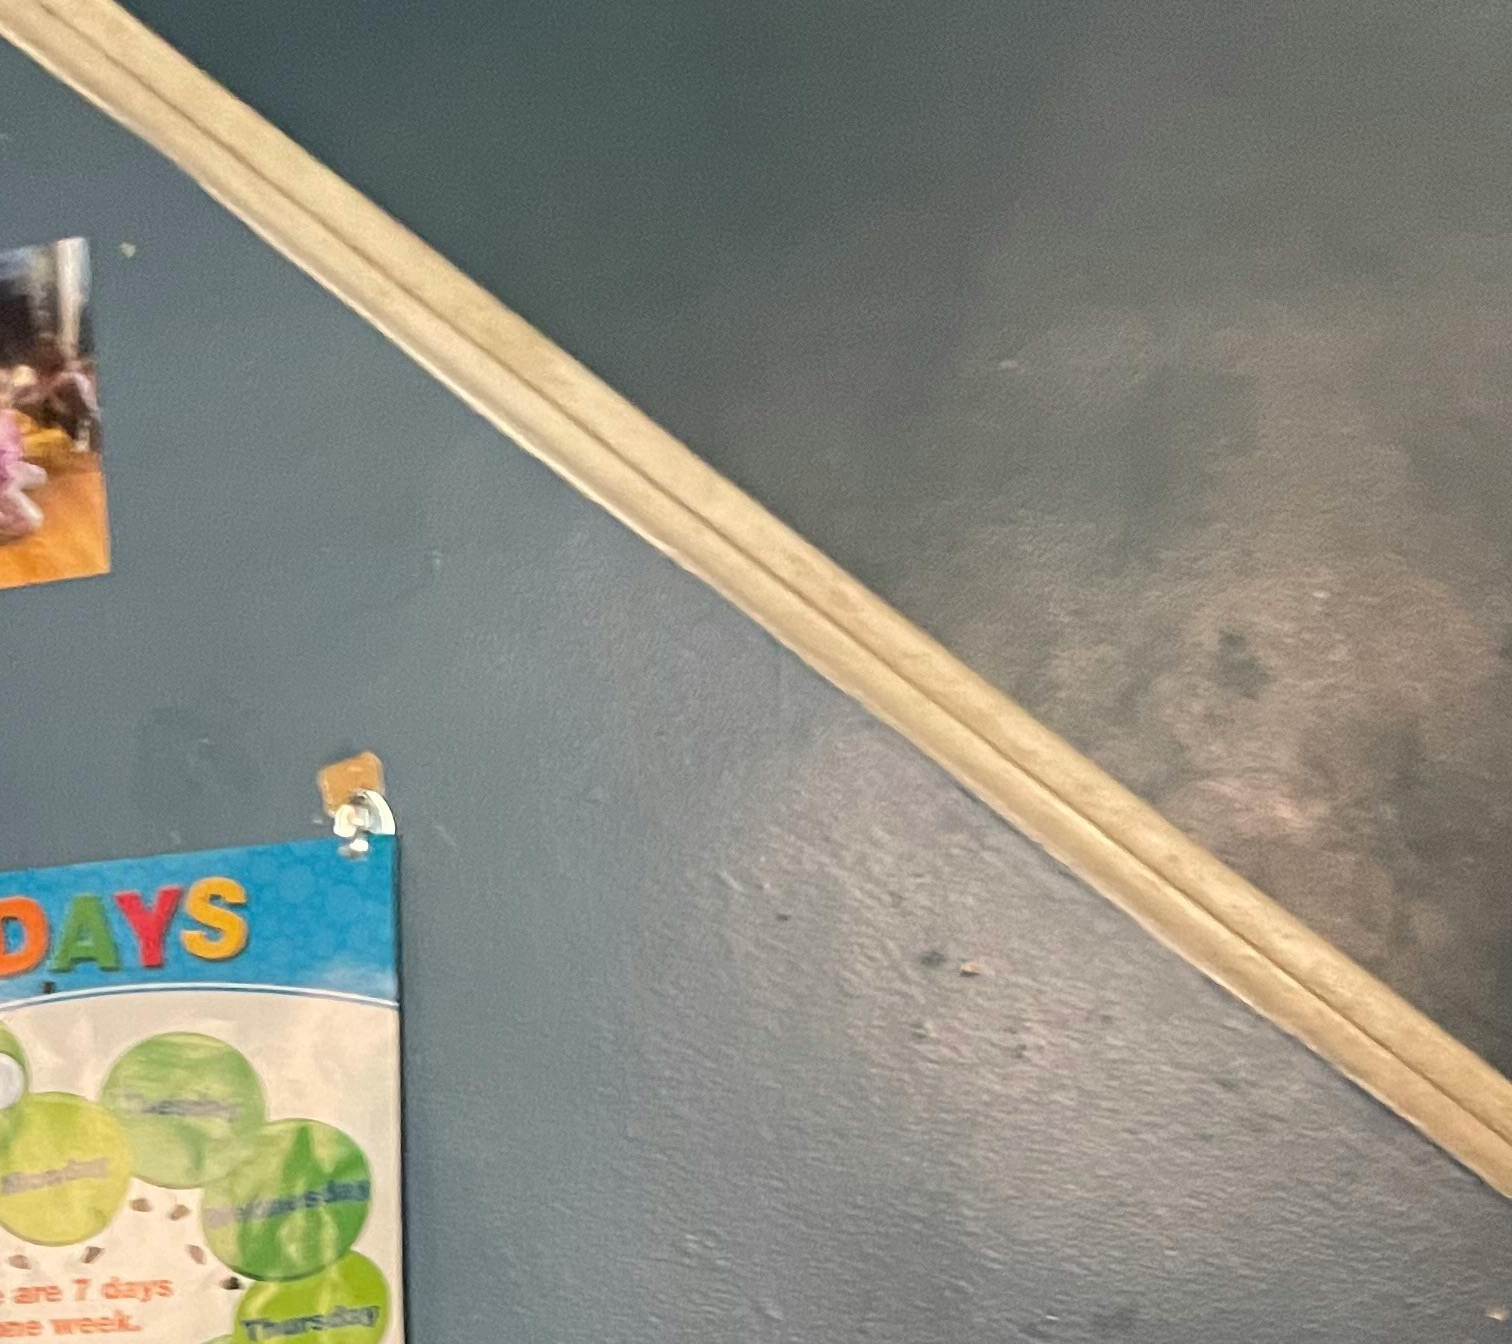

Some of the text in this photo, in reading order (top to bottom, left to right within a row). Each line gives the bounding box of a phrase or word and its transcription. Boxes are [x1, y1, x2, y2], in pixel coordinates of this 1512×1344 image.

[13, 1282, 62, 1305] are
[72, 1278, 92, 1302] 7
[101, 1276, 176, 1303] days
[242, 1304, 381, 1342] Thursday
